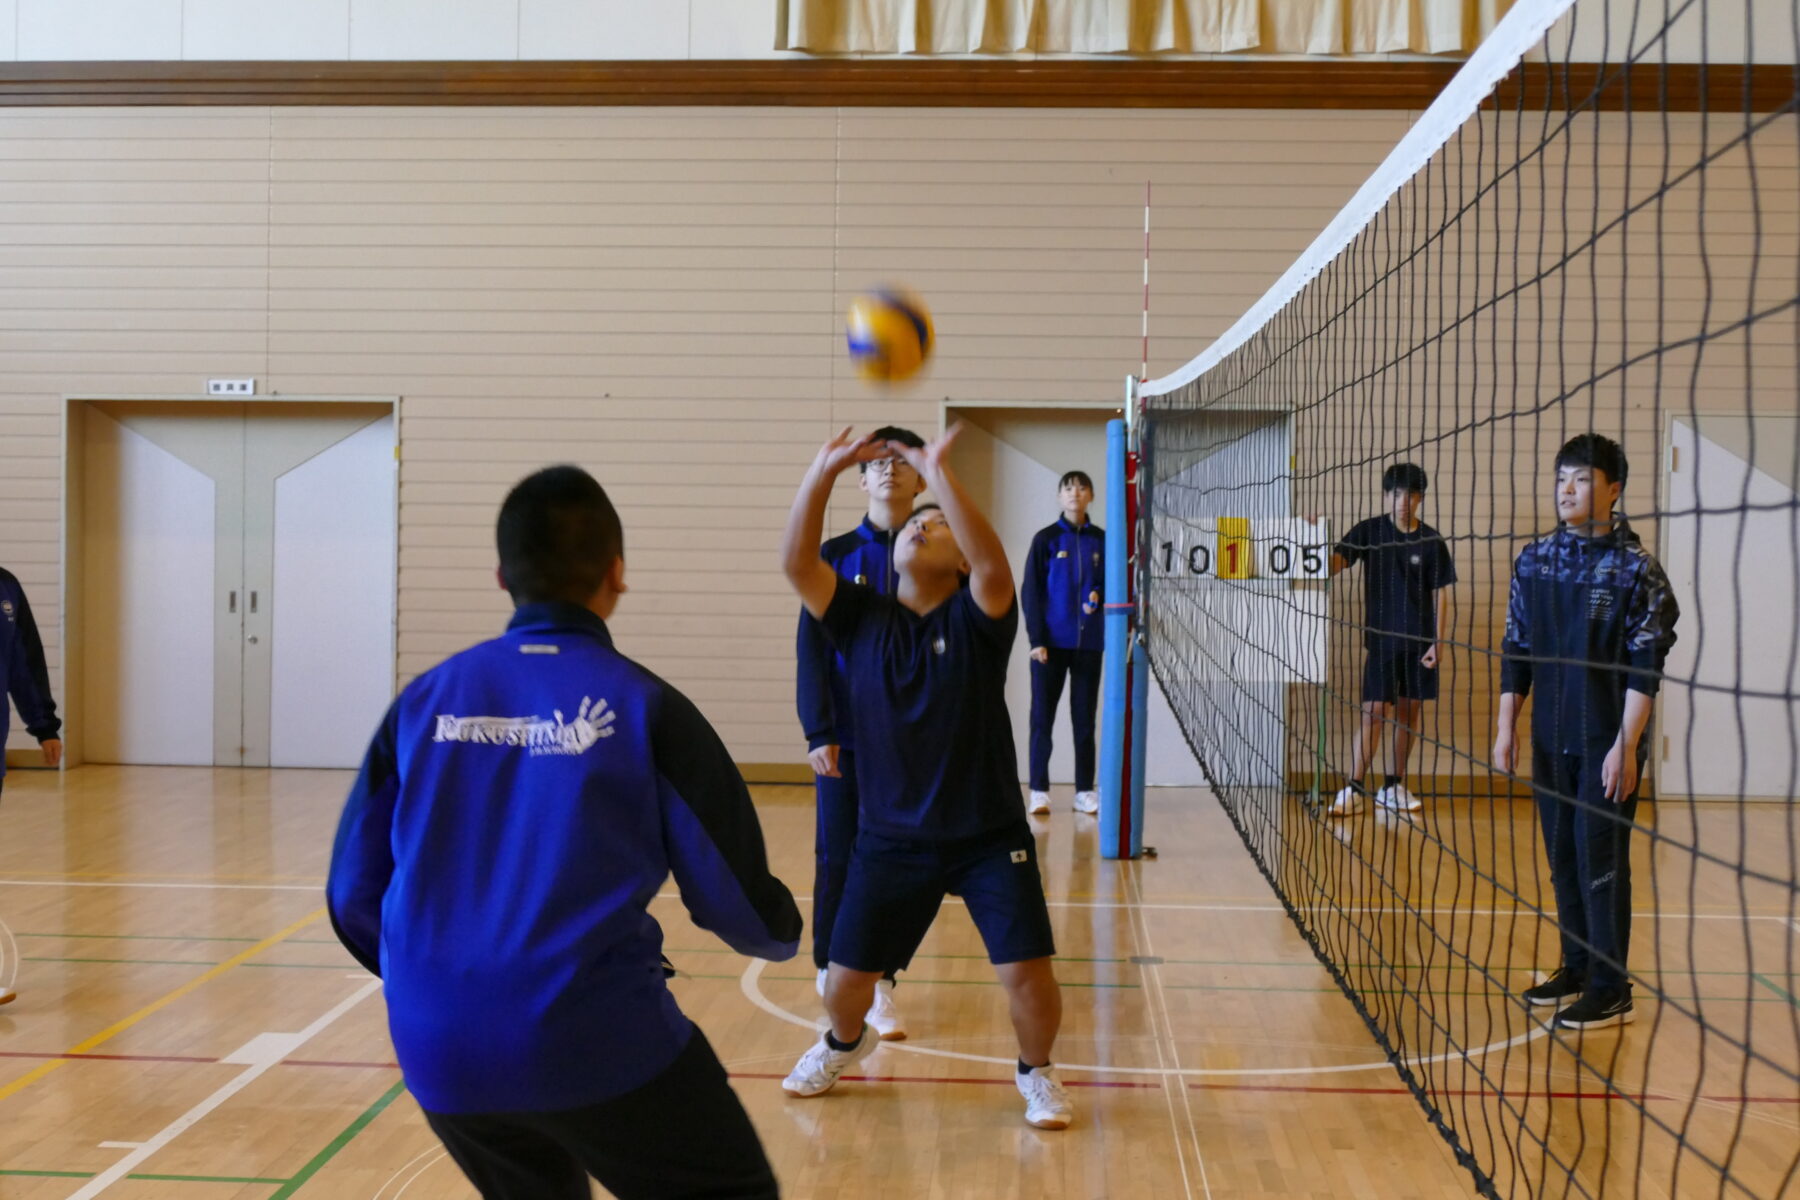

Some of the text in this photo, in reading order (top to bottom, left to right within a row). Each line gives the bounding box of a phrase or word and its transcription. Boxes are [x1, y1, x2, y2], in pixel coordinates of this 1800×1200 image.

[1161, 541, 1322, 574] 10 1 05
